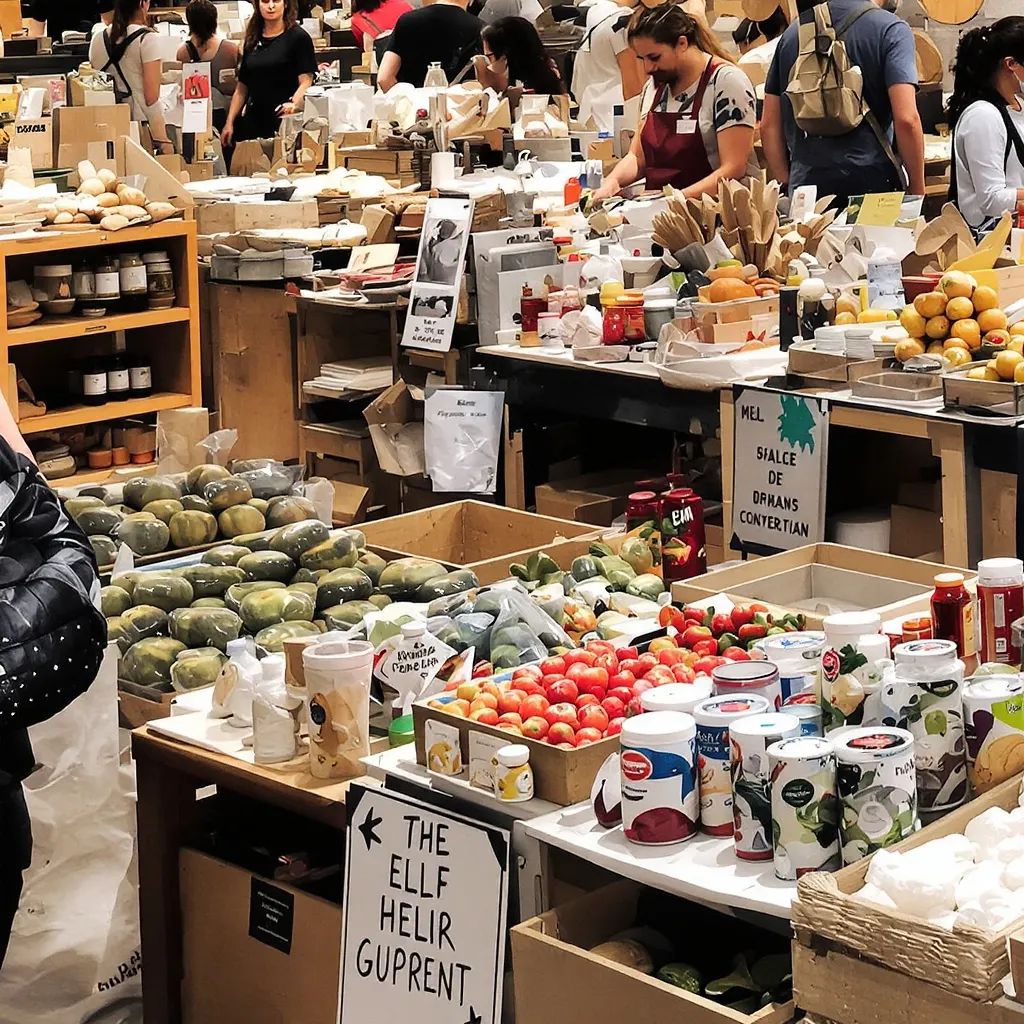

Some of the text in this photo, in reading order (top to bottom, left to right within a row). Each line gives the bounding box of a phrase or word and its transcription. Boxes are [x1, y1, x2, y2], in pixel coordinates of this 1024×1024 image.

[741, 405, 765, 423] MEL
[768, 470, 784, 486] DE
[403, 815, 451, 856] THE
[389, 853, 451, 899] ELLF
[379, 894, 456, 952] HELIR
[356, 938, 472, 1007] GUPRENT
